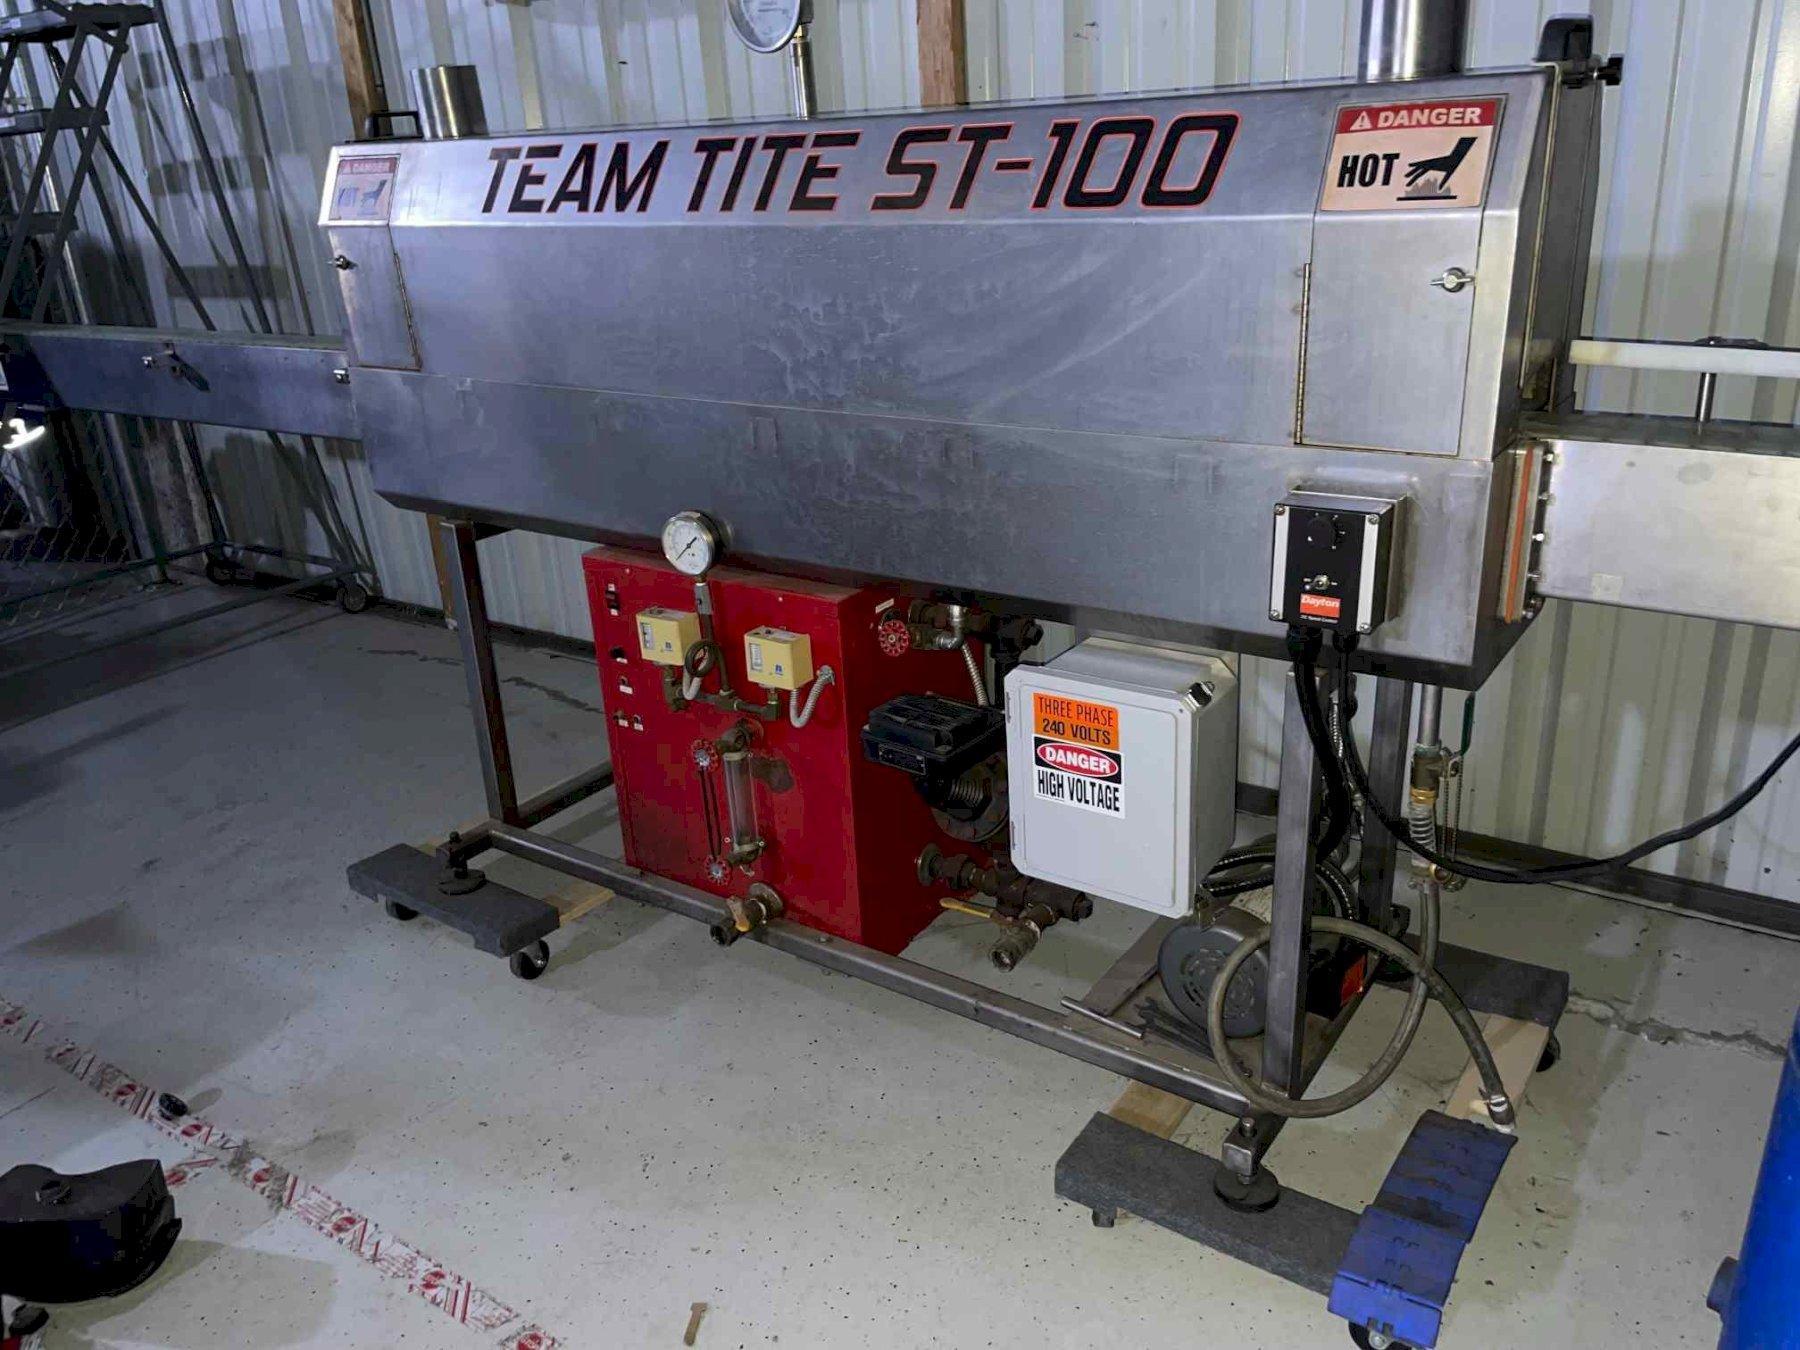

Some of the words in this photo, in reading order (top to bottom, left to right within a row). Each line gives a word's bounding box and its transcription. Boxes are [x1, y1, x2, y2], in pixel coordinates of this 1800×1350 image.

[1378, 108, 1482, 129] DANGER
[481, 139, 671, 213] TEAM
[686, 130, 862, 213] TITE
[870, 111, 1242, 210] ST-100
[1337, 153, 1400, 188] HOT
[1301, 594, 1340, 609] Dayton
[1038, 696, 1072, 719] THREE
[1076, 704, 1114, 727] PHASE
[1042, 718, 1065, 736] 240
[1070, 724, 1111, 745] VOLTS
[1045, 746, 1111, 774] DANGER
[1037, 770, 1065, 799] HIGH
[1067, 776, 1120, 812] VOLTAGE
